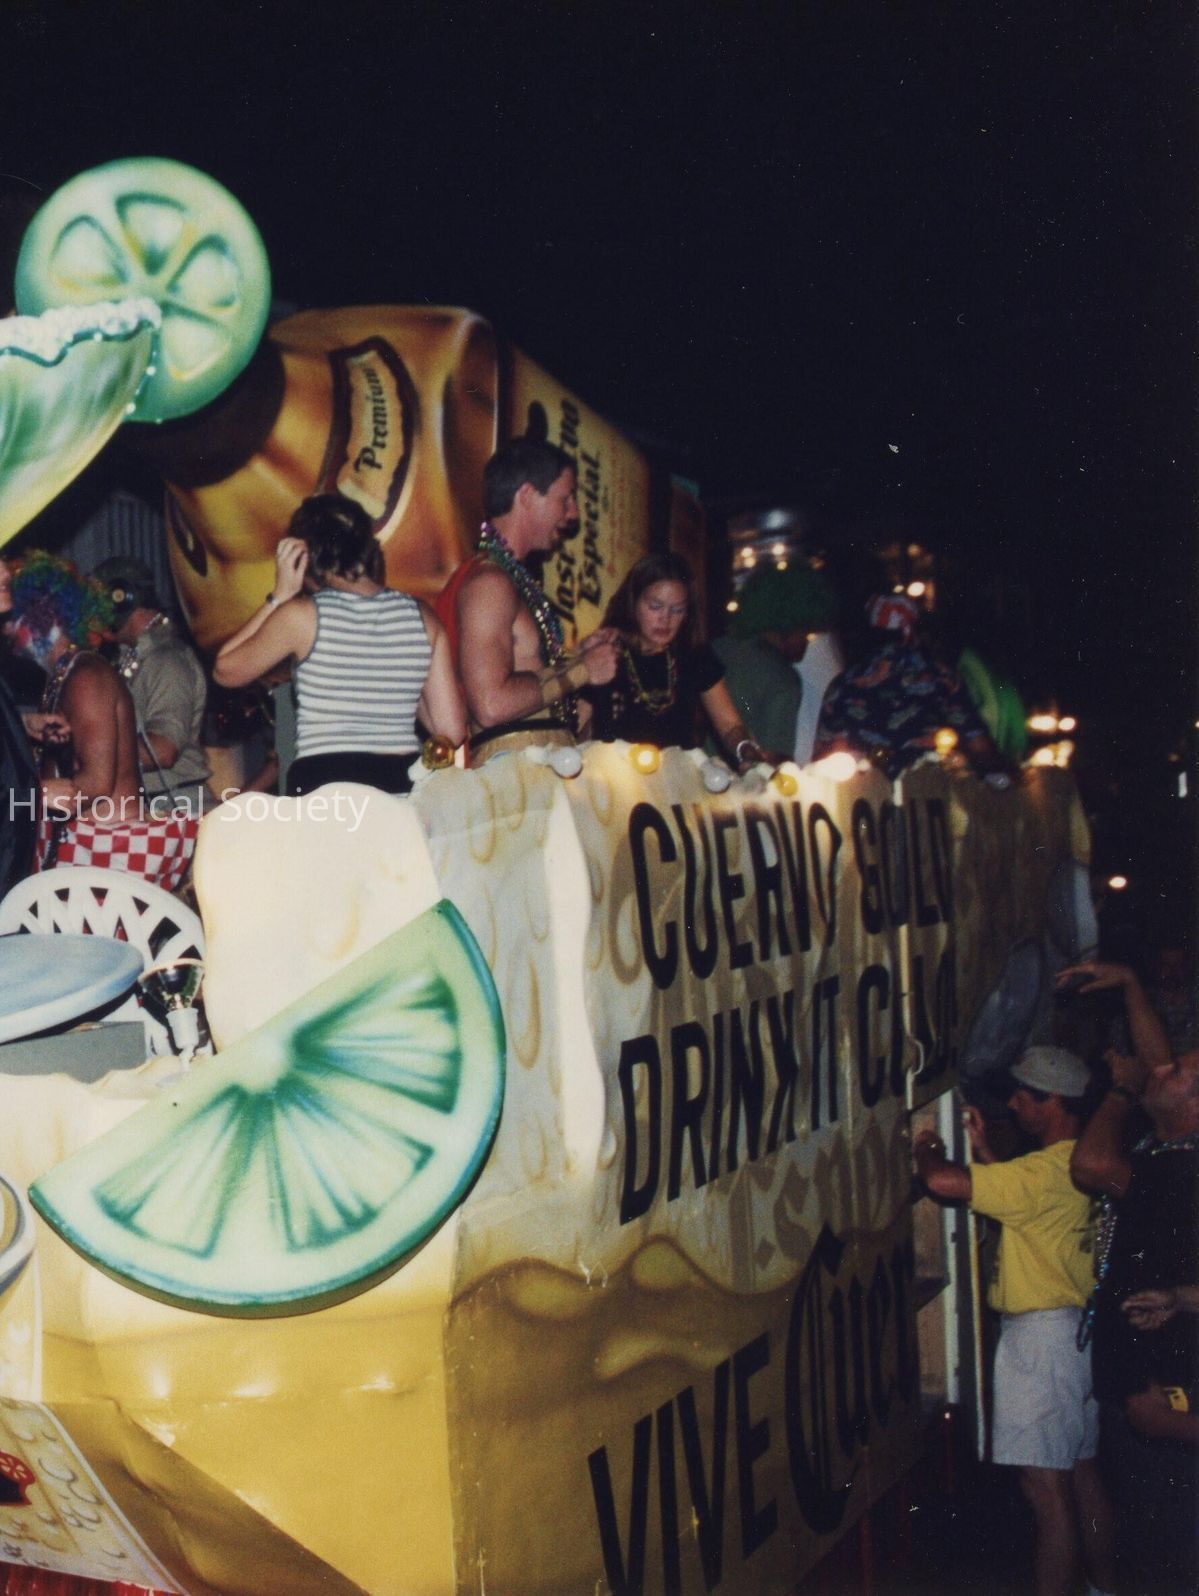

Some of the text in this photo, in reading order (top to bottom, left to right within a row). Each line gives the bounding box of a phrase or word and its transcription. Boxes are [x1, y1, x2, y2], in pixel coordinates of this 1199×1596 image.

[352, 364, 388, 474] Premium
[576, 452, 603, 609] Especial
[628, 799, 842, 990] CUERVO
[618, 990, 798, 1226] DRINK
[810, 976, 840, 1131] IT
[588, 1332, 778, 1596] VIVE
